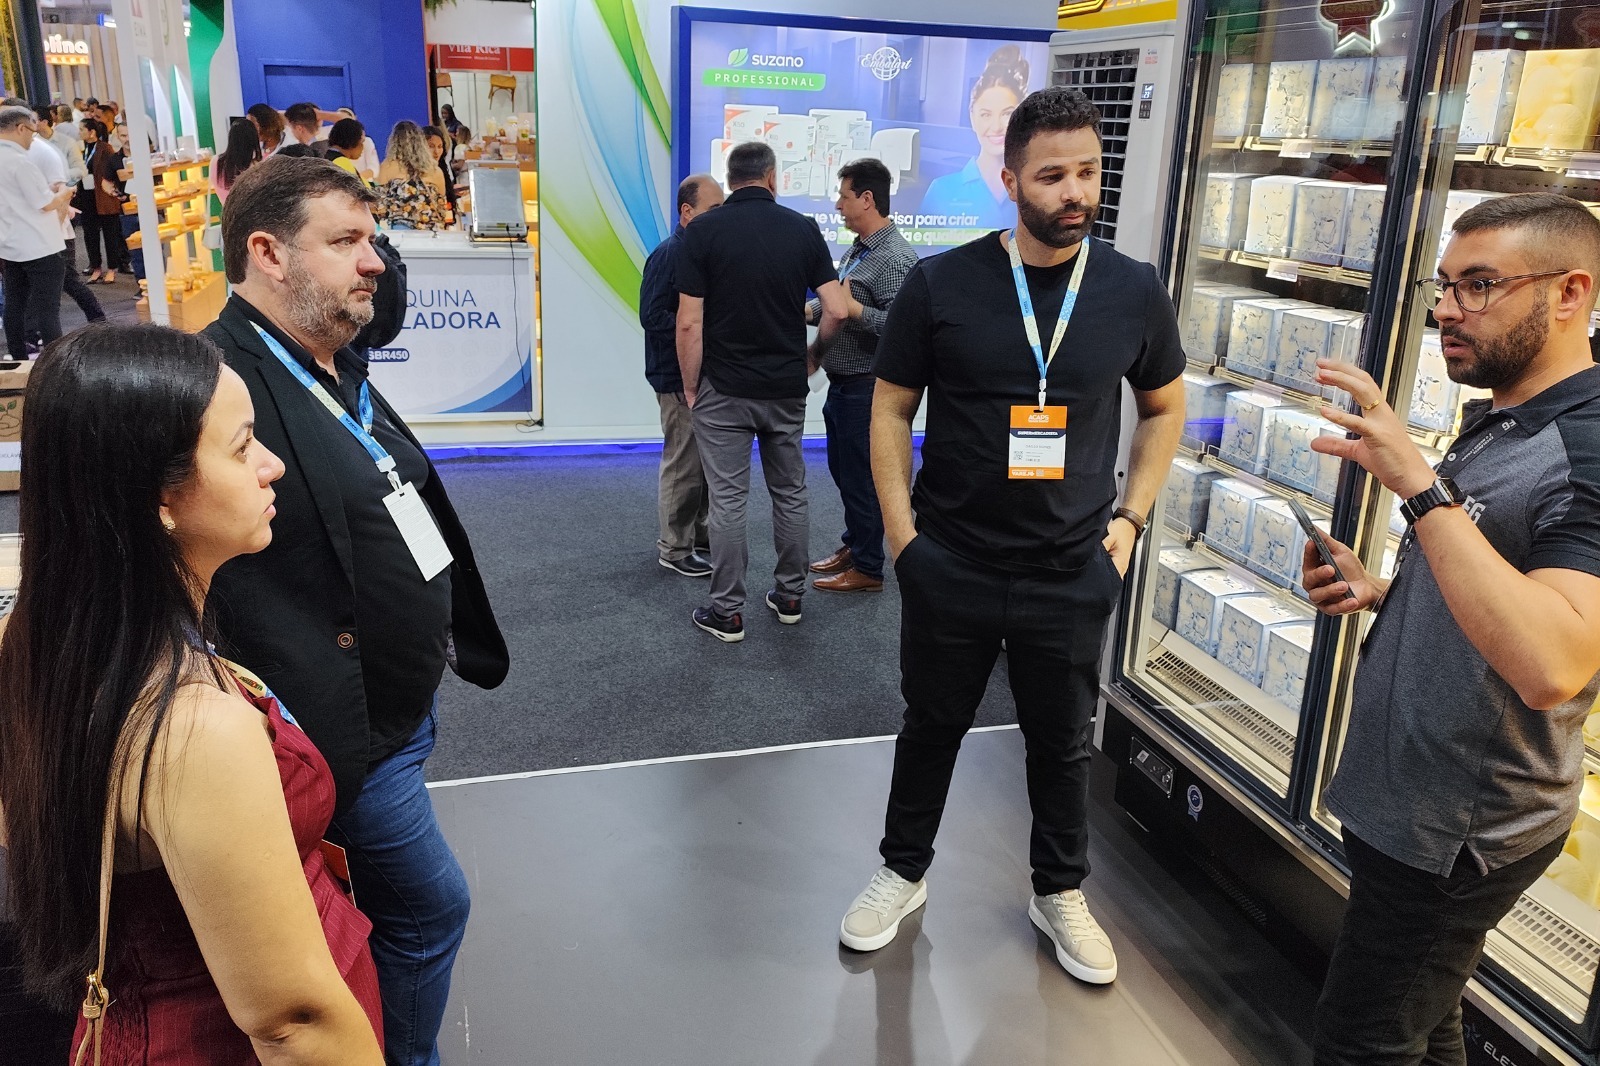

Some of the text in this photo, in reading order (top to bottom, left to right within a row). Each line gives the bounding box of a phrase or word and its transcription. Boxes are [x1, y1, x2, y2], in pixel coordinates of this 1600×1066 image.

[751, 54, 804, 67] suzano
[714, 72, 815, 87] PROFESSIONAL
[914, 213, 947, 228] para
[948, 212, 979, 226] criar
[406, 289, 477, 308] QUINA
[1502, 418, 1517, 431] FG
